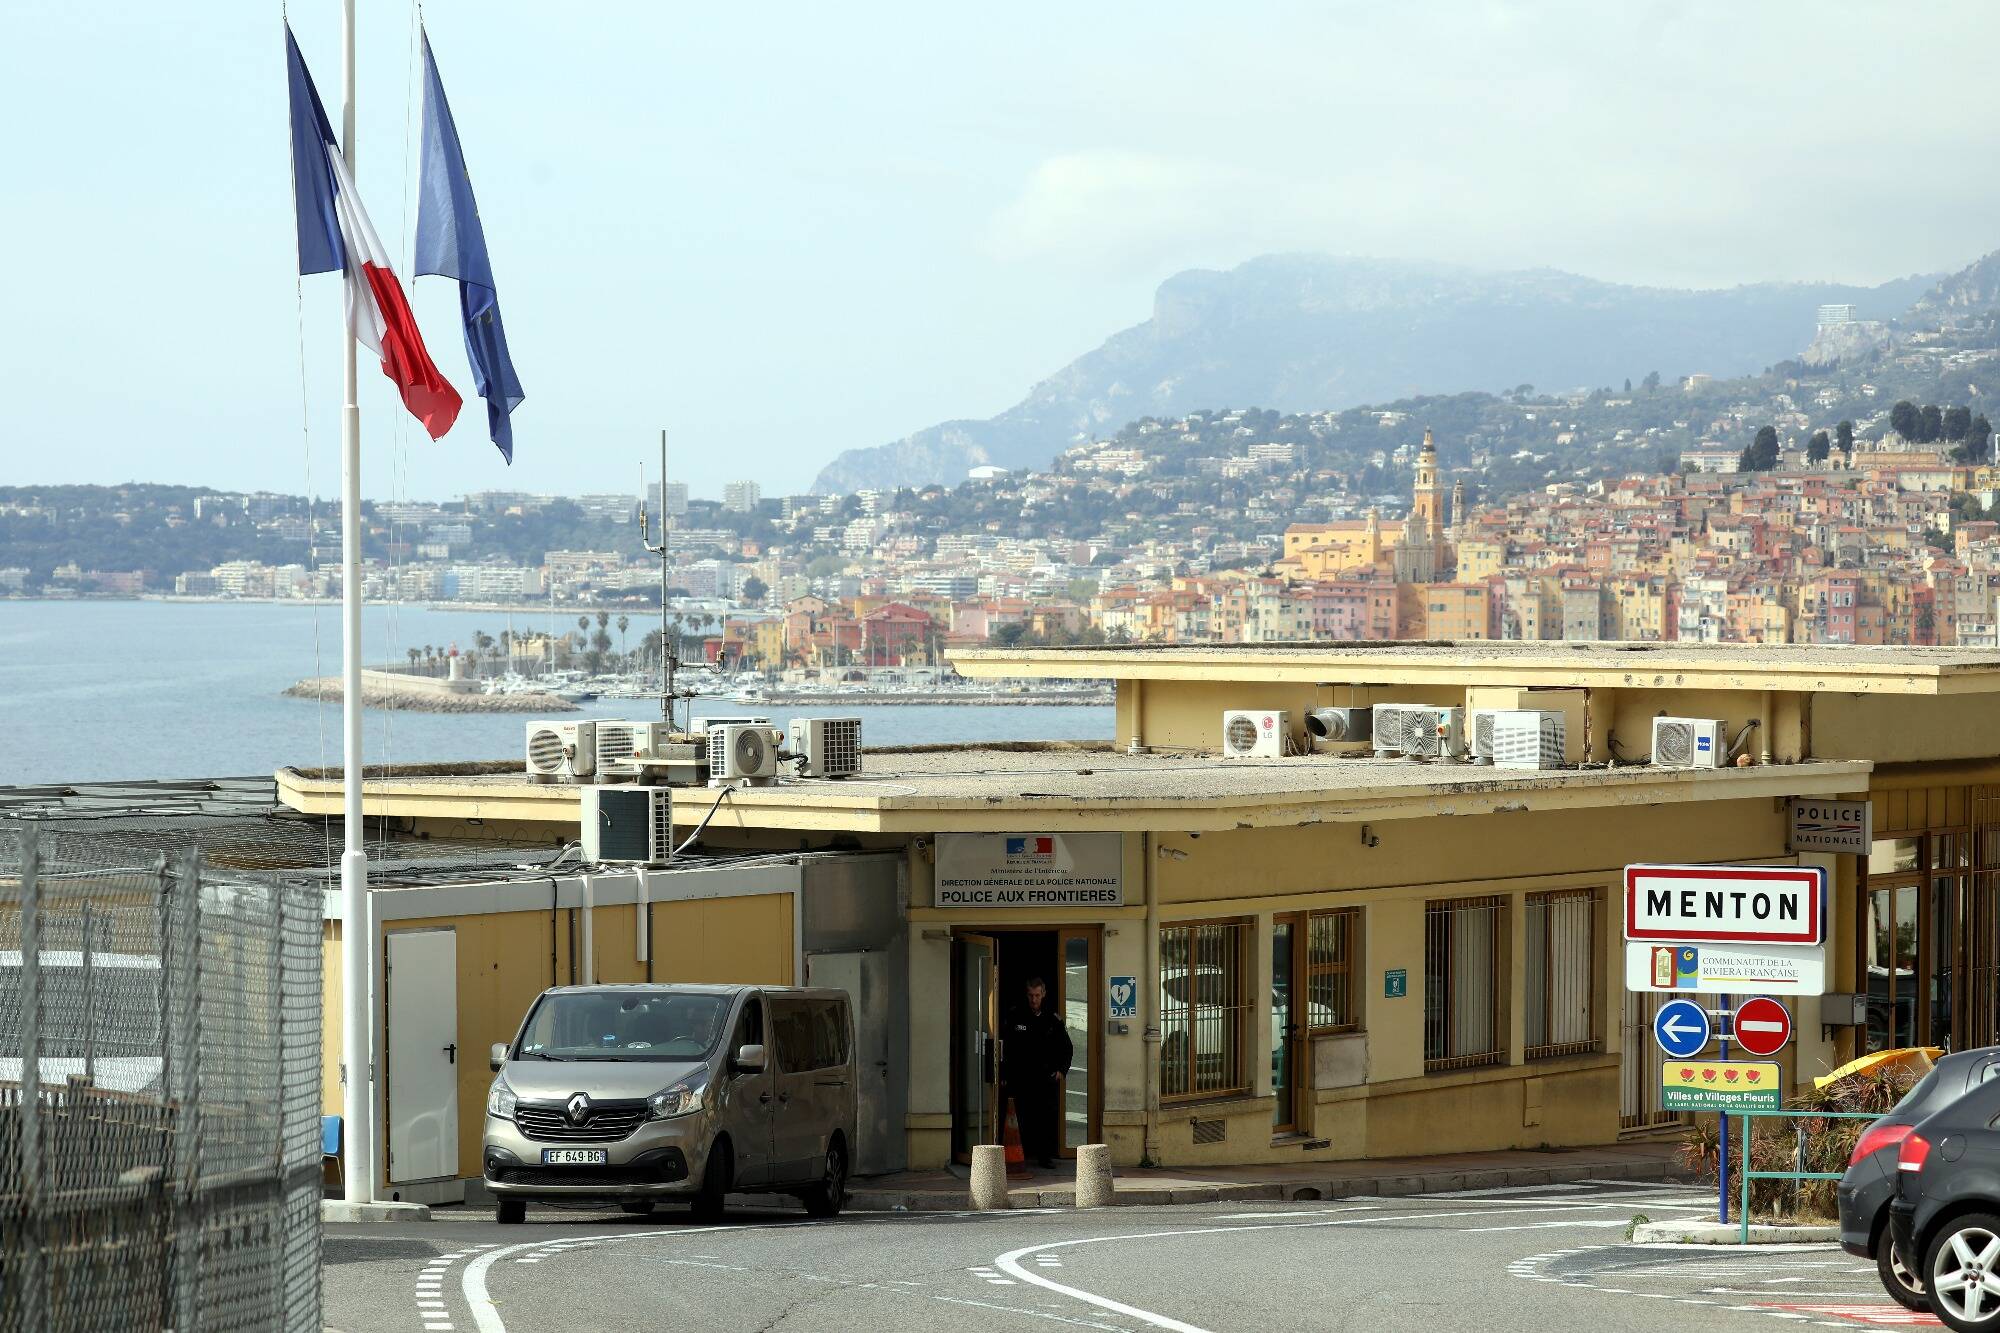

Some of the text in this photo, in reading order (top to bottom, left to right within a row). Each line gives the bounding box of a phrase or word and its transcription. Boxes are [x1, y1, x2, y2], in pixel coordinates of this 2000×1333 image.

[1797, 808, 1861, 821] POLICE
[1796, 835, 1861, 845] NATIONALE
[941, 890, 1117, 902] POLICE AUX FRONTIERES
[1647, 889, 1798, 921] MENTON
[1767, 959, 1779, 967] DE
[1703, 968, 1799, 978] RIVIERA FRANÇAISE
[1110, 1007, 1136, 1016] DAE
[1667, 1092, 1775, 1104] Villes et Villages Fleuris
